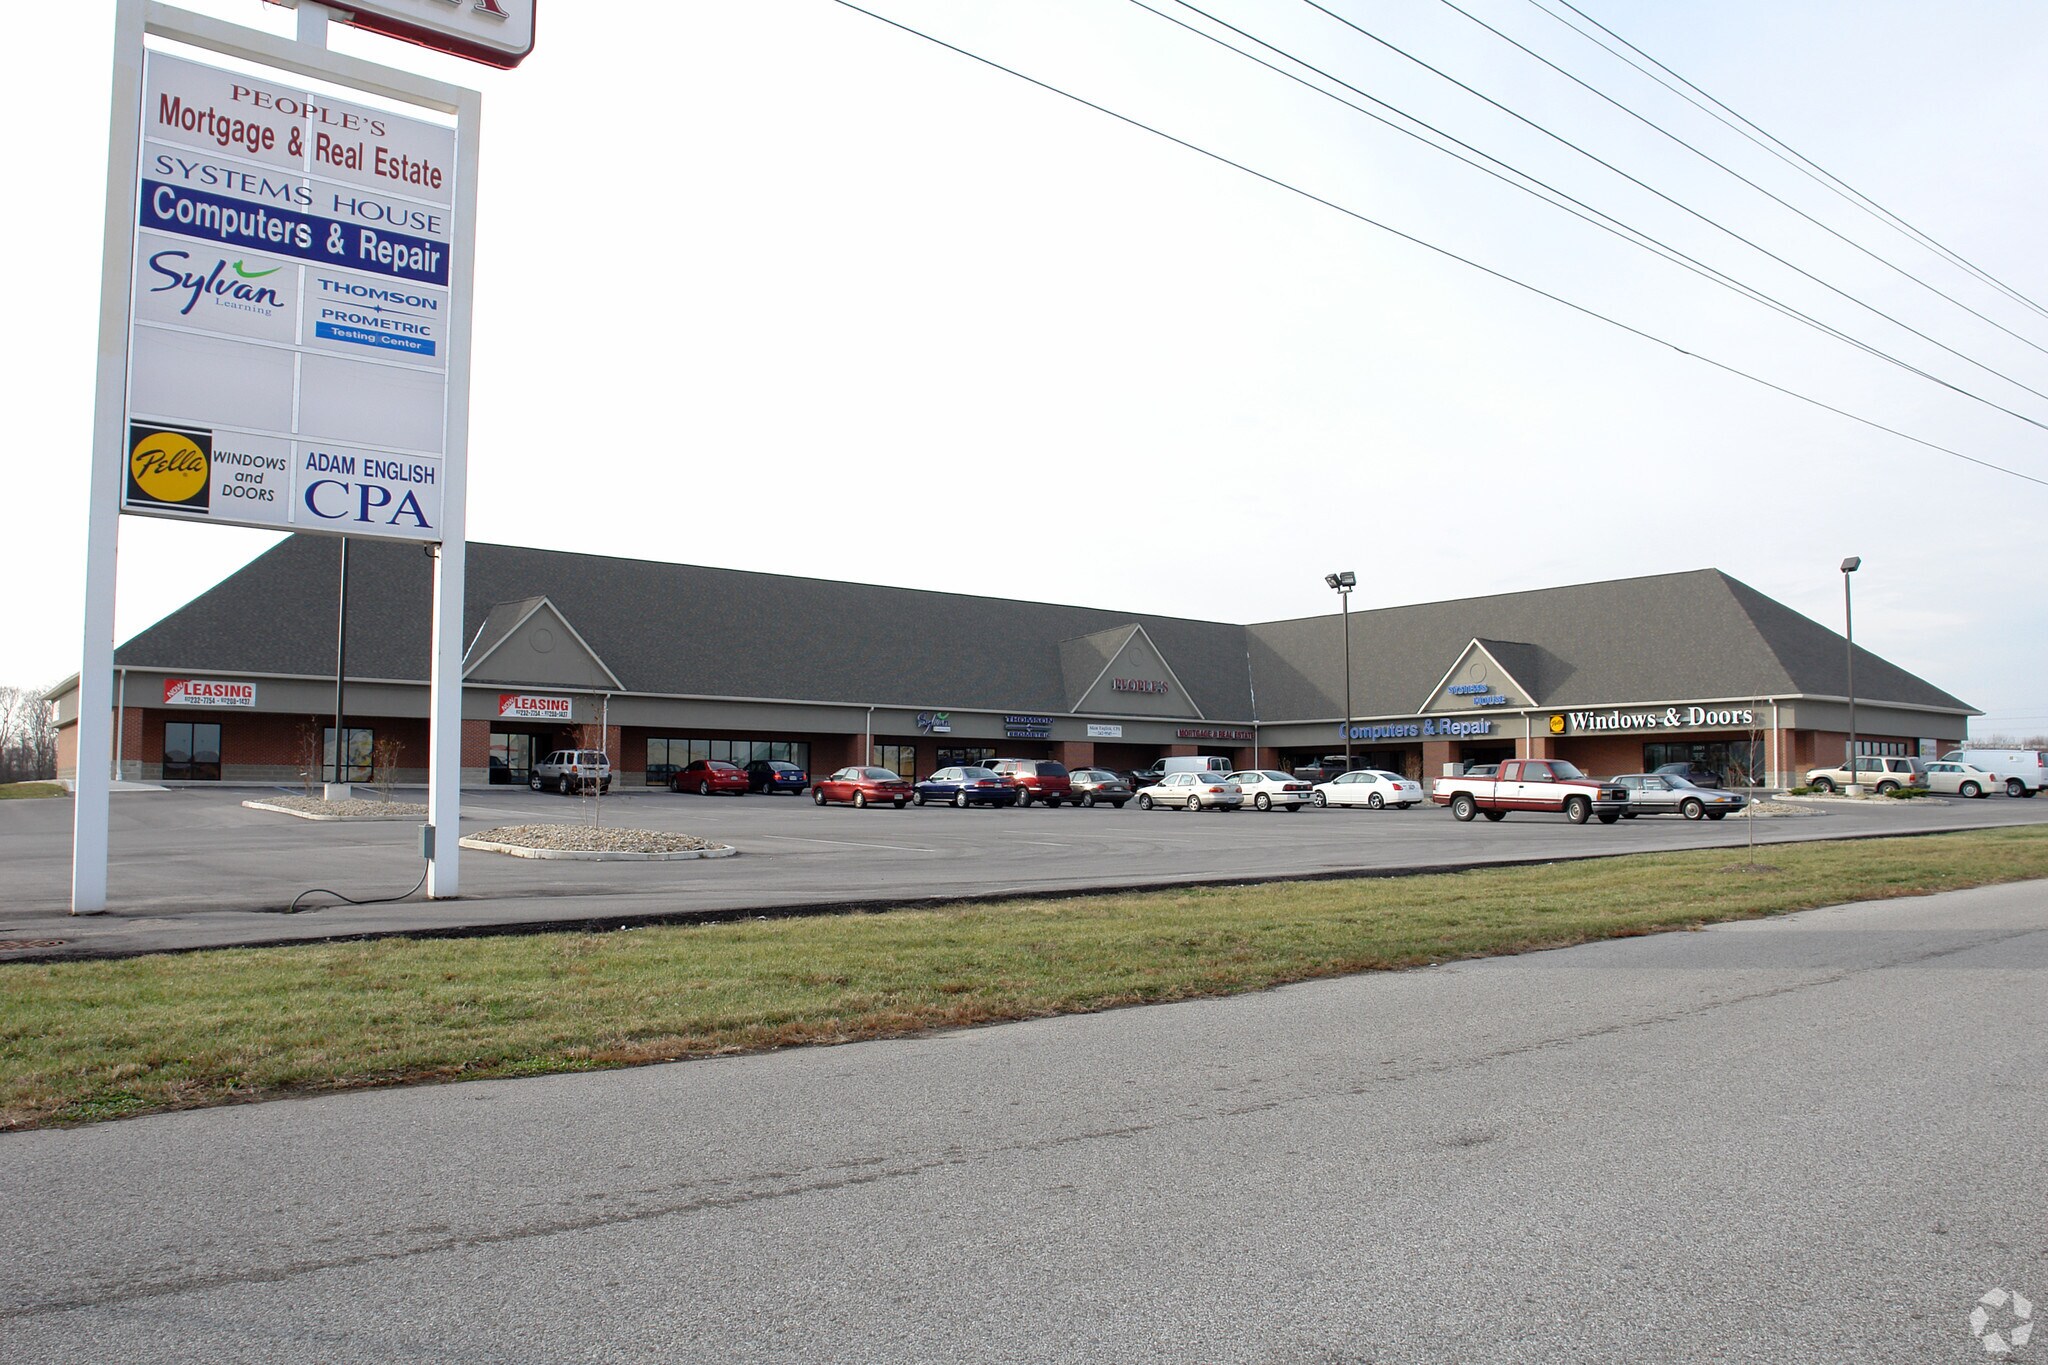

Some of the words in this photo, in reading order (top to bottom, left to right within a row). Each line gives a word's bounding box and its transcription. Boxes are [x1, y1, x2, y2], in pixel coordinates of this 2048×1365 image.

[230, 83, 387, 138] PEOPLE'S
[158, 93, 275, 155] Mortgage
[287, 126, 304, 158] &
[315, 132, 364, 172] Real
[374, 147, 442, 190] Estate
[154, 154, 313, 207] SYSTEMS
[333, 194, 442, 236] HOUSE
[152, 185, 312, 249] Computers
[326, 222, 345, 255] &
[359, 230, 440, 273] Repair
[149, 250, 285, 316] Sylvan
[317, 278, 438, 311] THOMSON
[215, 297, 273, 317] Learning
[321, 308, 432, 336] PROMETRIC
[330, 326, 376, 344] Testing
[381, 334, 422, 350] Center
[135, 448, 204, 480] Pella
[213, 450, 287, 472] WINDOWS
[305, 452, 356, 476] ADAM
[363, 458, 436, 485] ENGLISH
[234, 470, 265, 485] and
[221, 484, 275, 503] DOORS
[304, 479, 434, 529] CPA
[167, 682, 184, 698] NOW
[183, 682, 253, 698] LEASING
[1112, 678, 1169, 694] PEOPLE'S
[1448, 684, 1488, 695] SYSTEMS
[501, 697, 514, 711] NOW
[514, 697, 569, 711] LEASING
[1473, 696, 1506, 705] HOUSE
[1338, 722, 1418, 741] Computers
[1423, 718, 1435, 736] &
[1439, 717, 1491, 738] Repair
[1569, 710, 1657, 730] Windows
[1663, 707, 1682, 727] &
[1688, 706, 1753, 726] Doors
[1178, 729, 1212, 739] MORTGAGE
[1218, 730, 1233, 739] REAL
[1234, 731, 1255, 740] ESTATE
